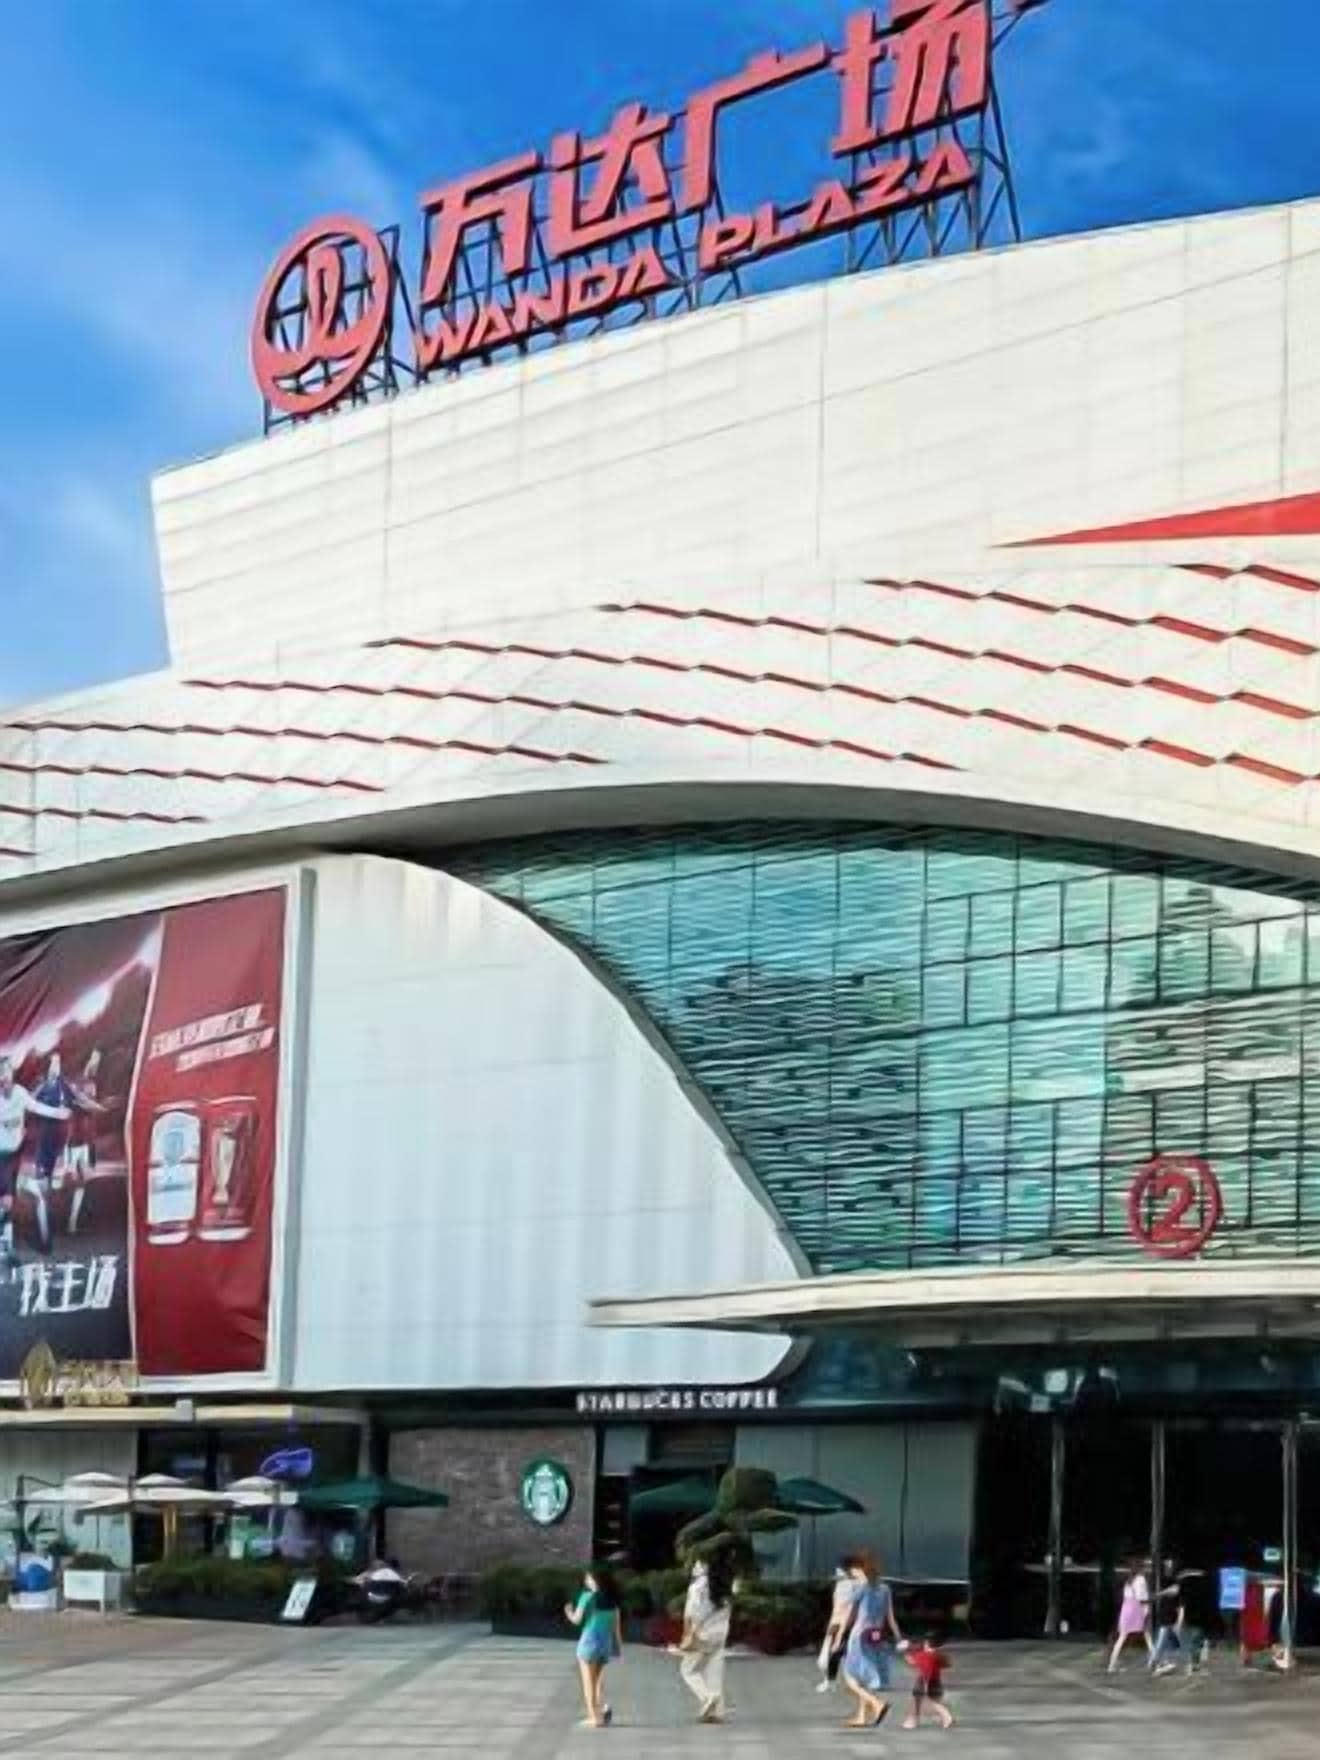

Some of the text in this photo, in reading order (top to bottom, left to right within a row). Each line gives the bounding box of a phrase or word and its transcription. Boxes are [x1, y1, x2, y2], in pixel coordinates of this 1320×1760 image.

[416, 0, 989, 306] 万达广场
[416, 137, 979, 370] WANDA PLAZA
